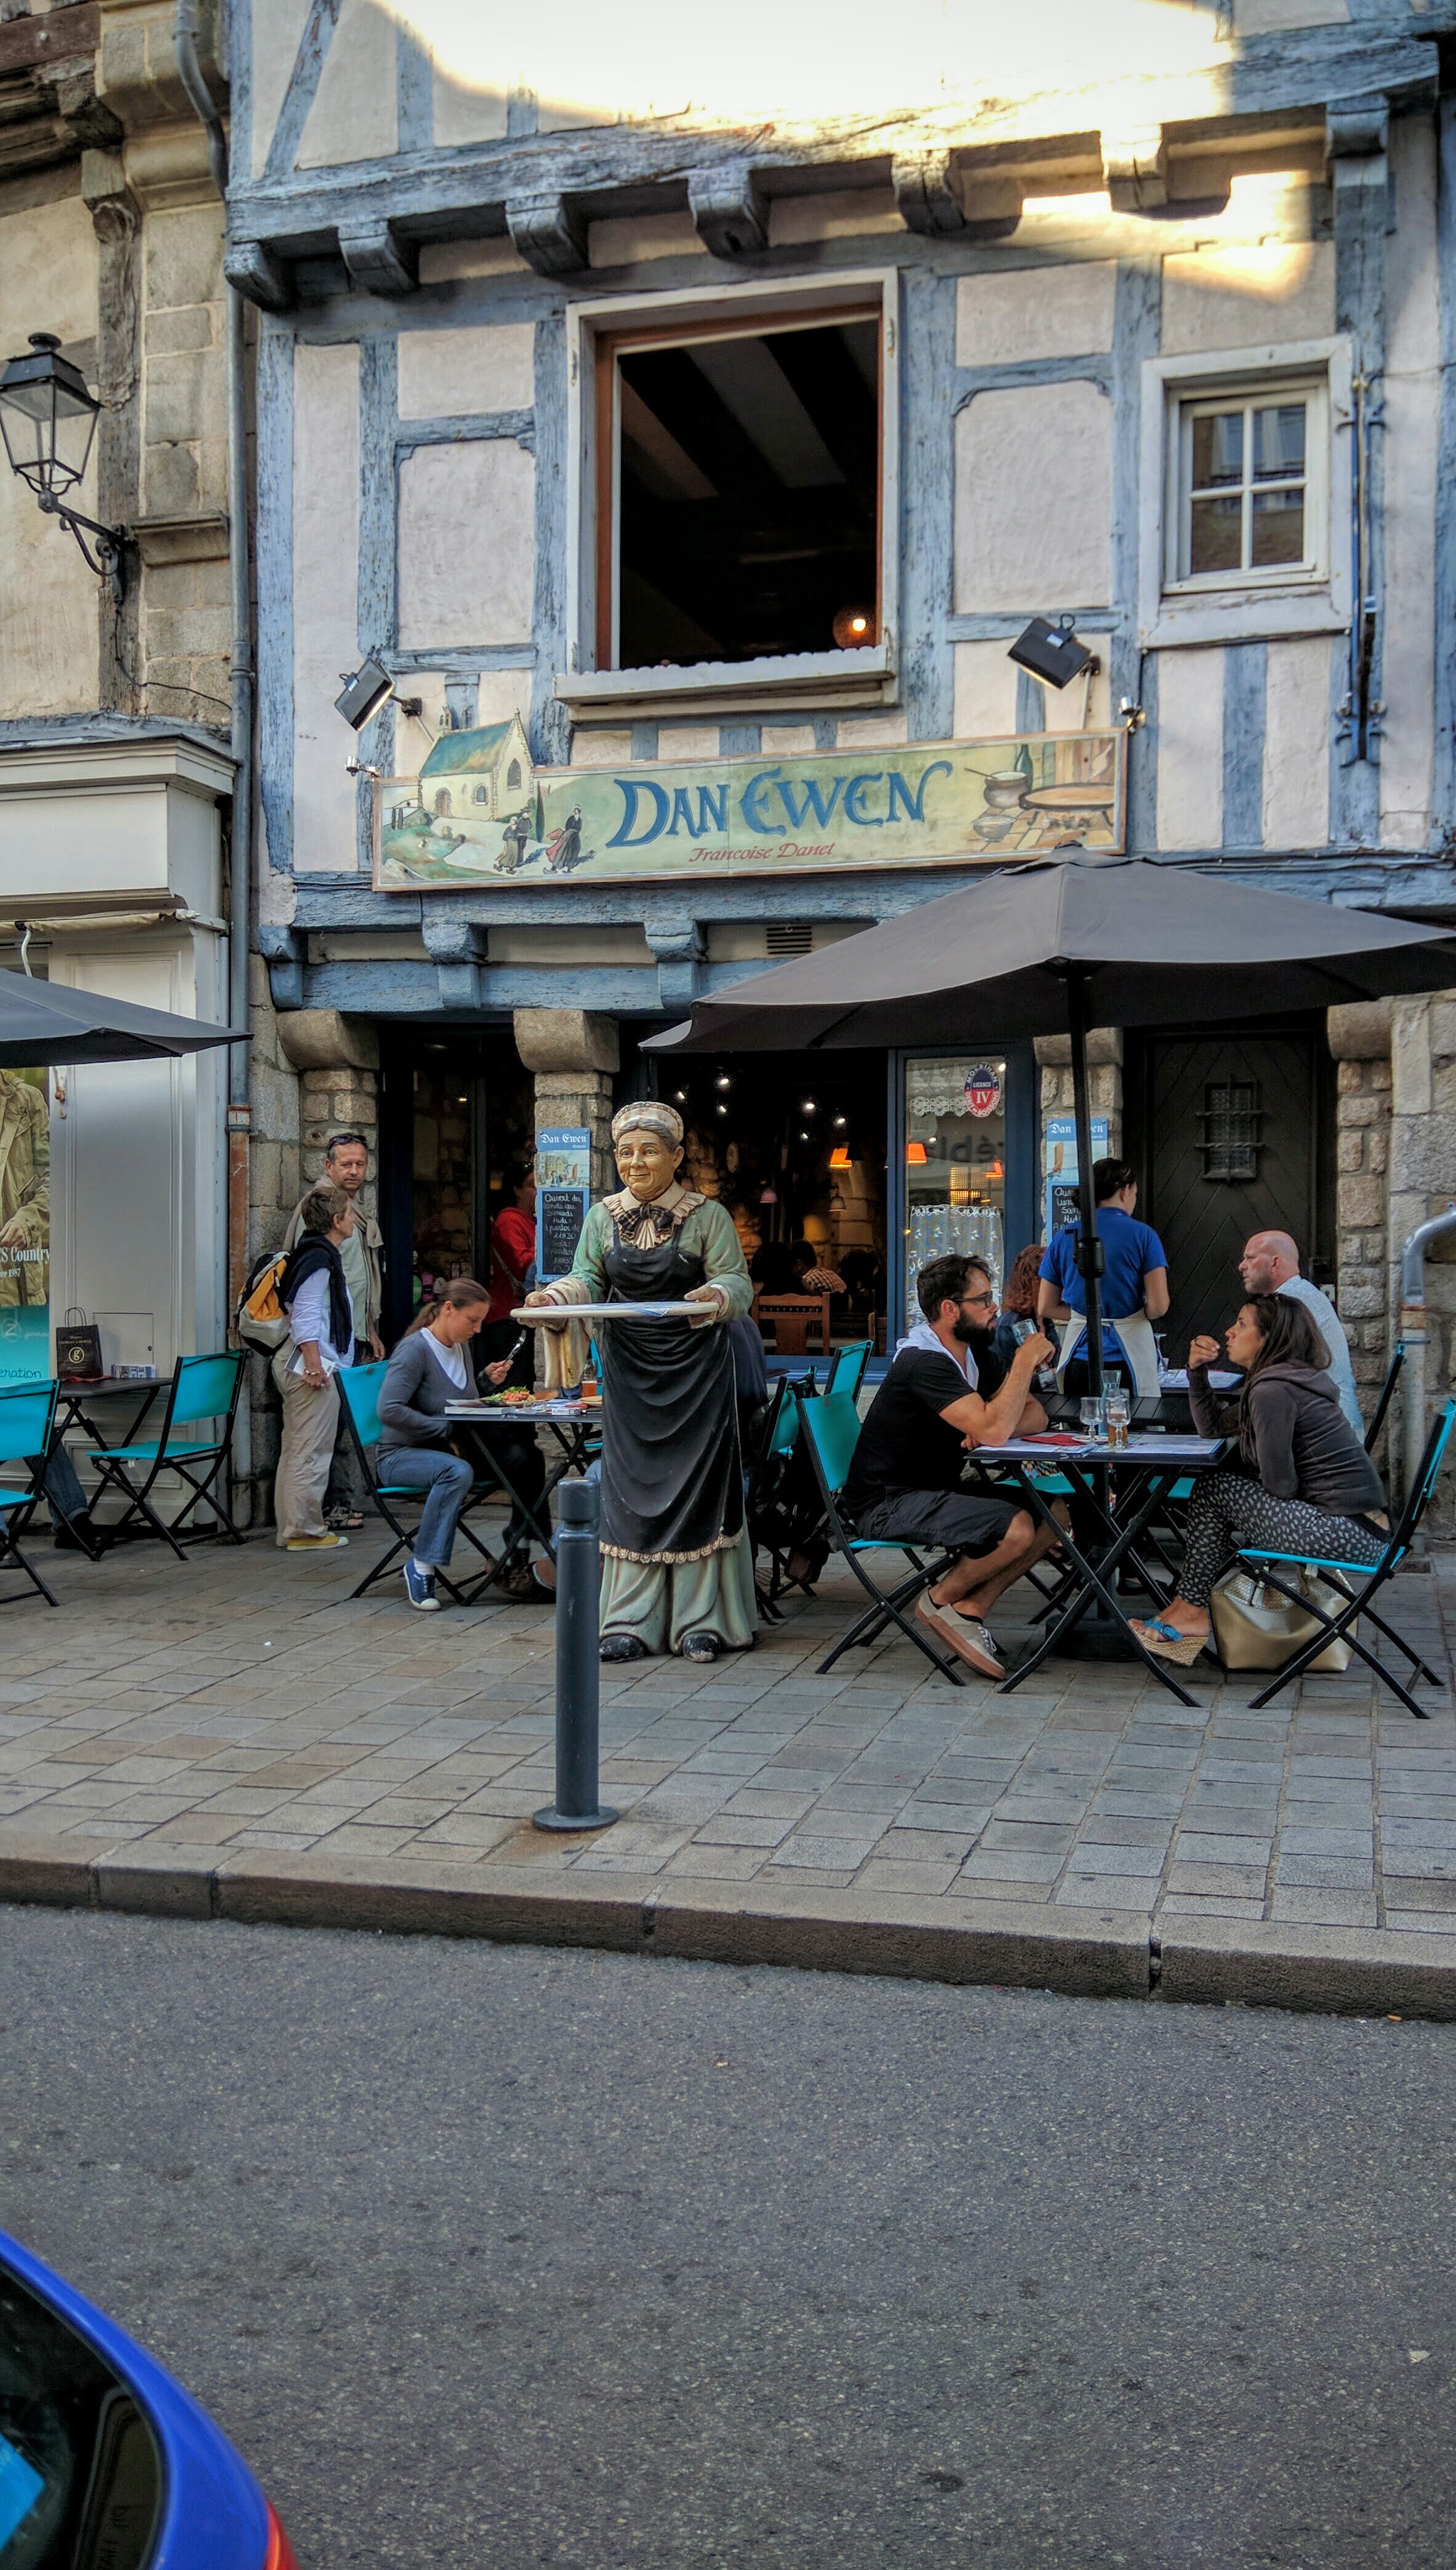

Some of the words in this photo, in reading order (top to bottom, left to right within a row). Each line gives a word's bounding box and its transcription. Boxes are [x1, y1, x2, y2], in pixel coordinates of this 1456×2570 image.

[605, 778, 730, 849] DAN
[740, 759, 953, 837] EWEN
[777, 841, 836, 858] Danet
[977, 1091, 991, 1104] IV
[1050, 1123, 1071, 1134] Dan
[1090, 1124, 1103, 1133] en
[541, 1134, 559, 1143] Dan
[562, 1133, 586, 1143] Ewen
[10, 1246, 49, 1264] Country
